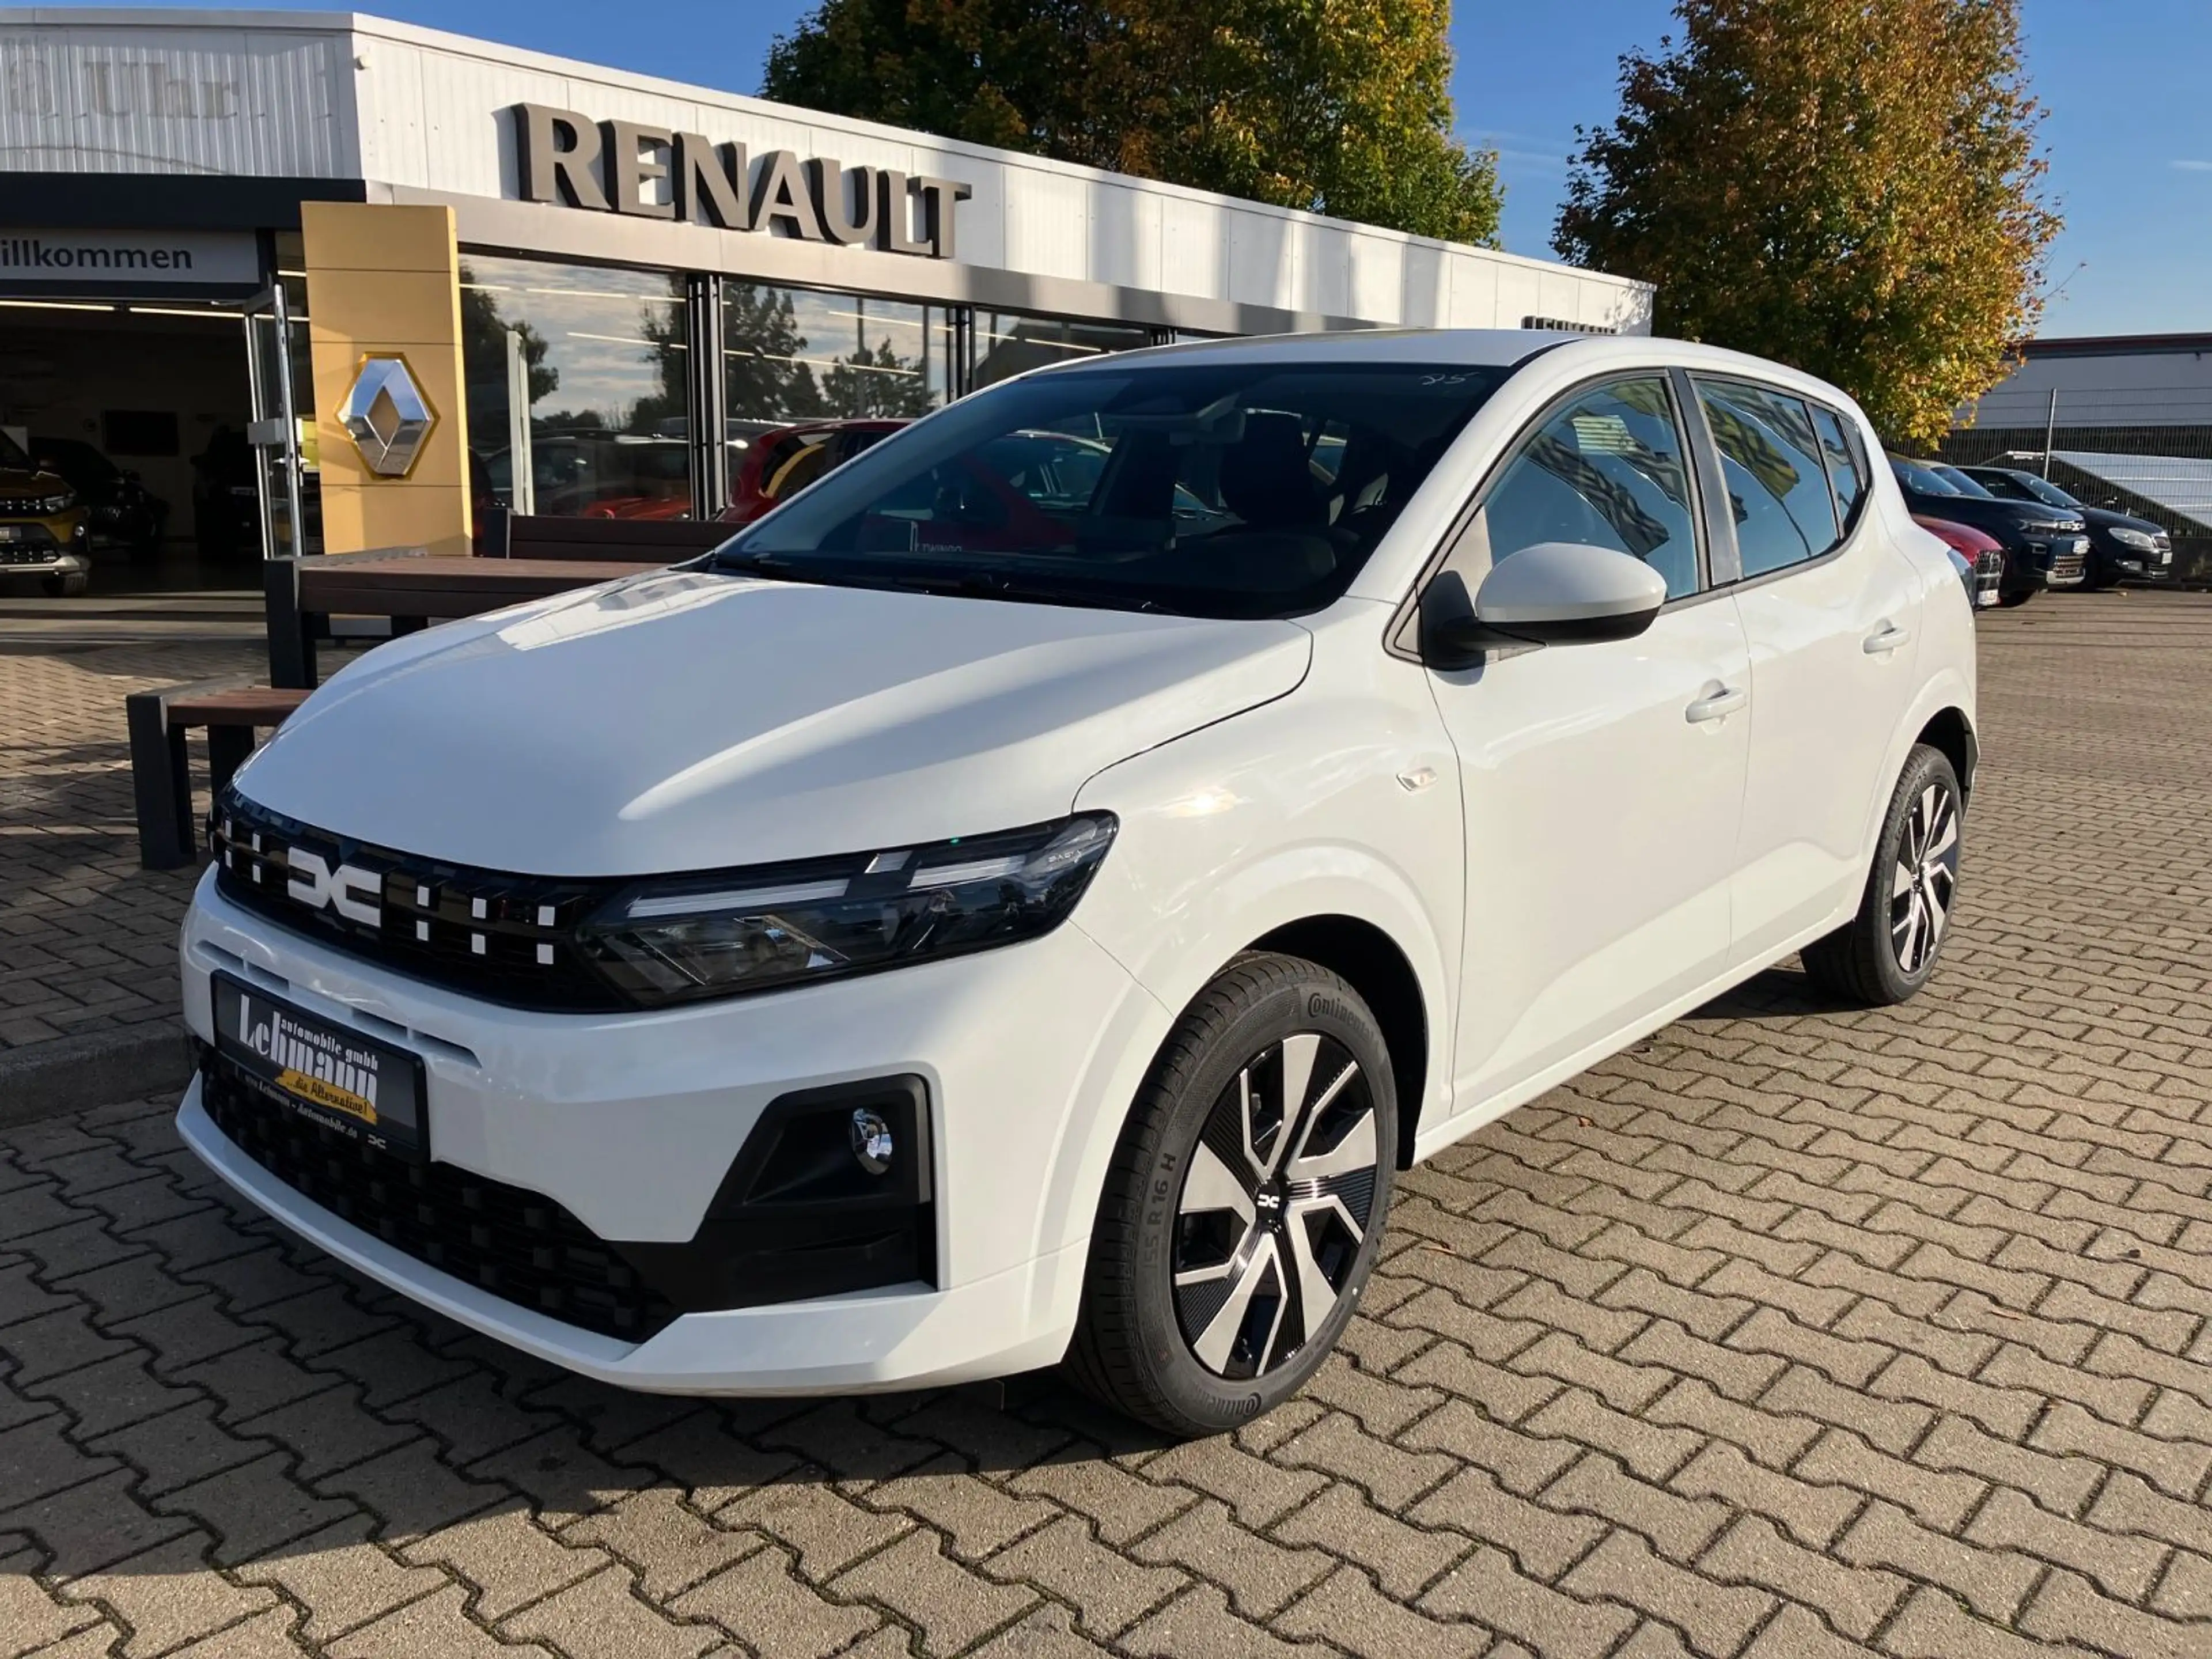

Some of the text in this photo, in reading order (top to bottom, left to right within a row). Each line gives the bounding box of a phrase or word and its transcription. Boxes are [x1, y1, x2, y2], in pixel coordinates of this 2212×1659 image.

[512, 102, 972, 259] RENAULT
[0, 240, 192, 269] illkommen
[1308, 992, 1374, 1040] Continental
[239, 994, 377, 1109] Lehmann
[281, 1018, 378, 1071] automobile gmbh
[1160, 1153, 1177, 1172] H
[1152, 1179, 1169, 1205] 16
